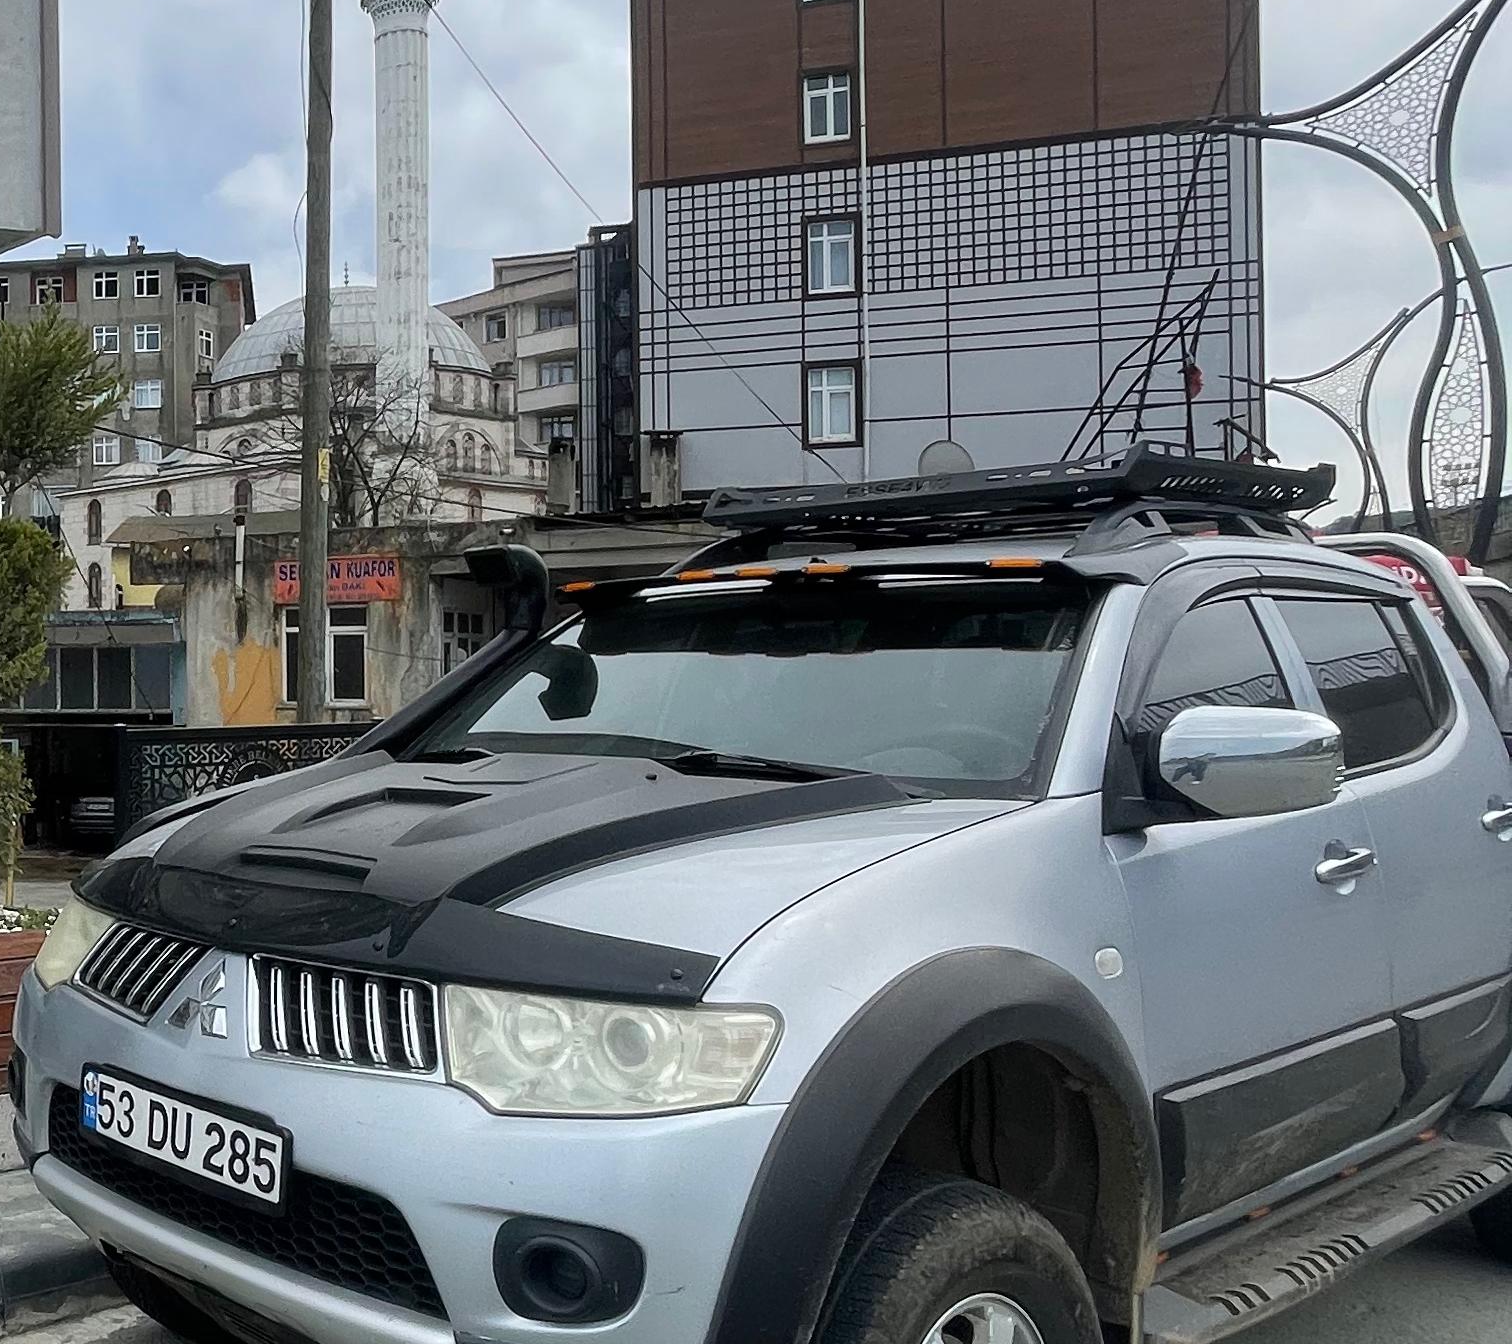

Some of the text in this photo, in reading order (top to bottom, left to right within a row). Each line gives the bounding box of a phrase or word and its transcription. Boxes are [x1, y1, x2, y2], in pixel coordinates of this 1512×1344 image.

[278, 561, 341, 582] SEN
[84, 1103, 96, 1121] TR
[97, 1080, 278, 1194] 53 DU 285
